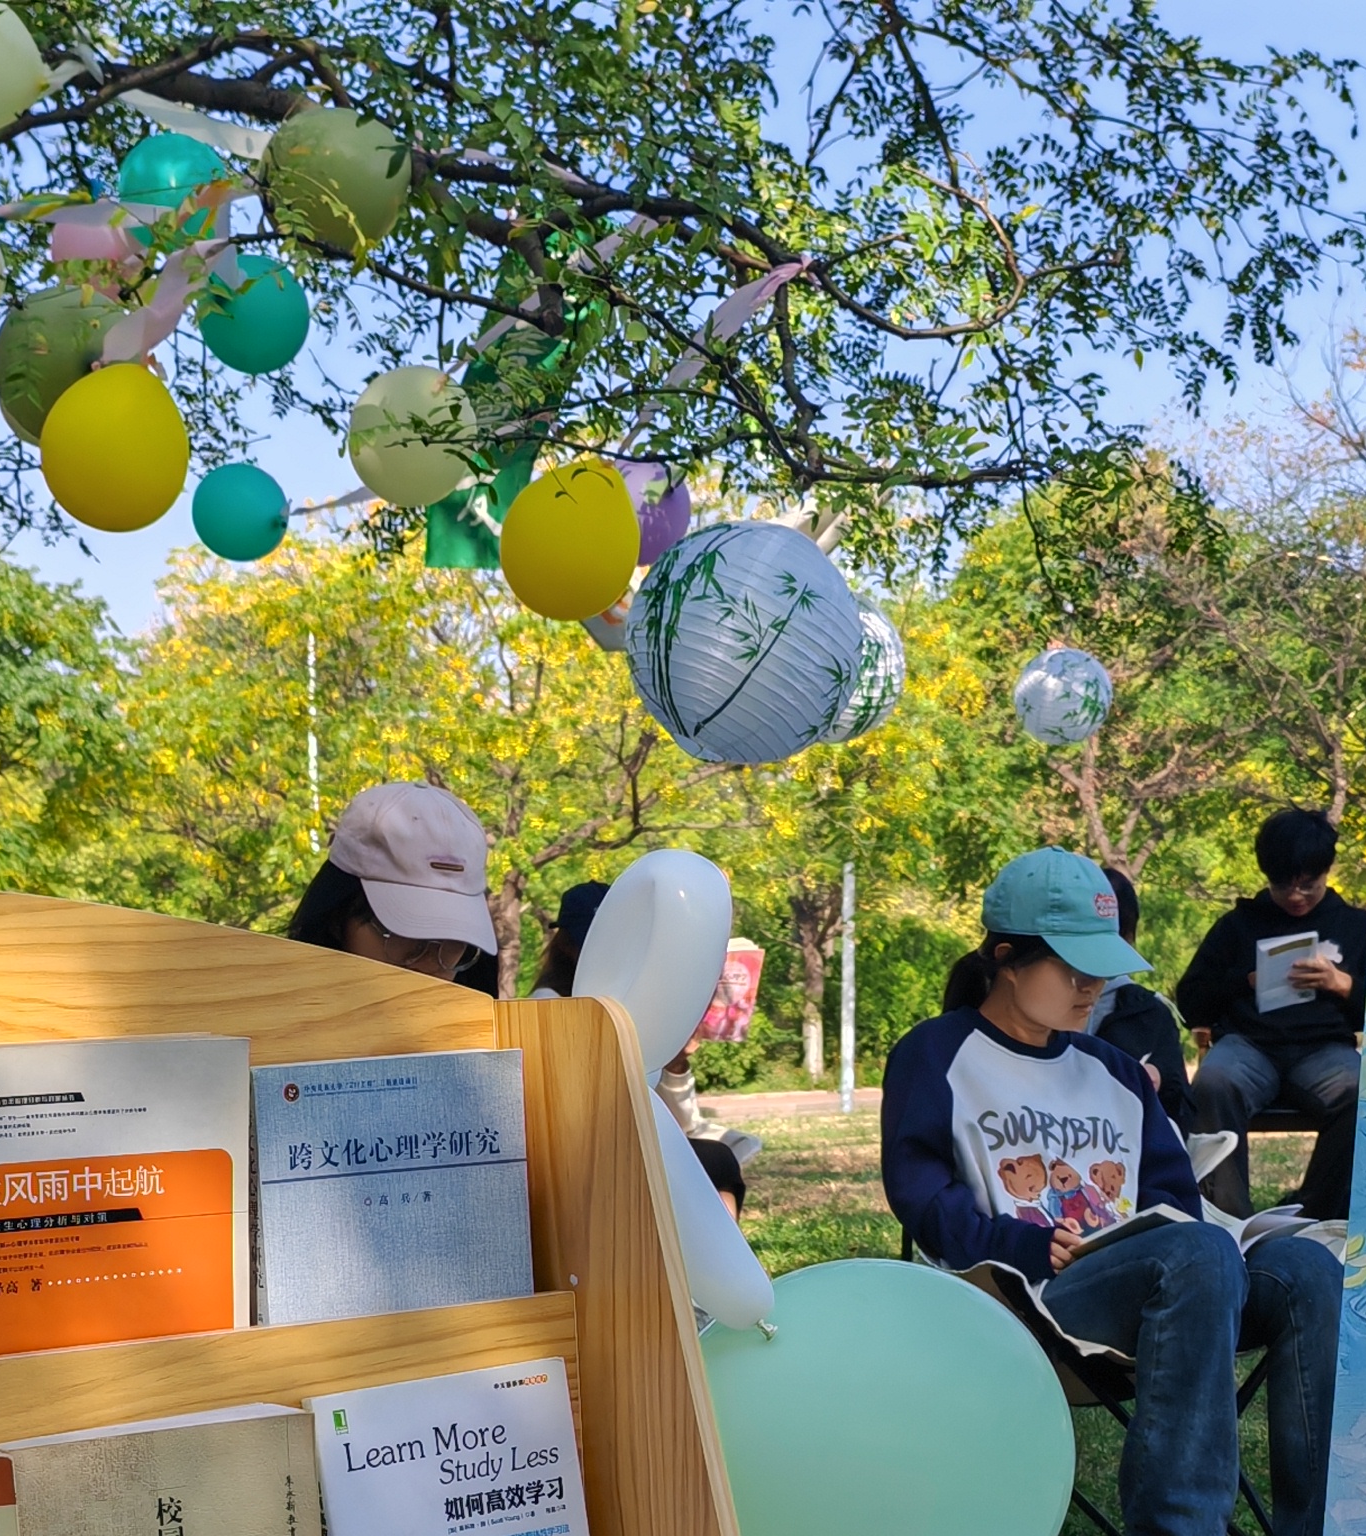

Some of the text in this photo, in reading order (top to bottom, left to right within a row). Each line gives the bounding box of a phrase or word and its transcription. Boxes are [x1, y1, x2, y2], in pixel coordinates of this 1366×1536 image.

[288, 1127, 501, 1172] 跨文化心理学研究
[344, 1423, 507, 1472] Learn More
[439, 1445, 559, 1486] Study Less
[444, 1476, 565, 1522] 如何高效学习
